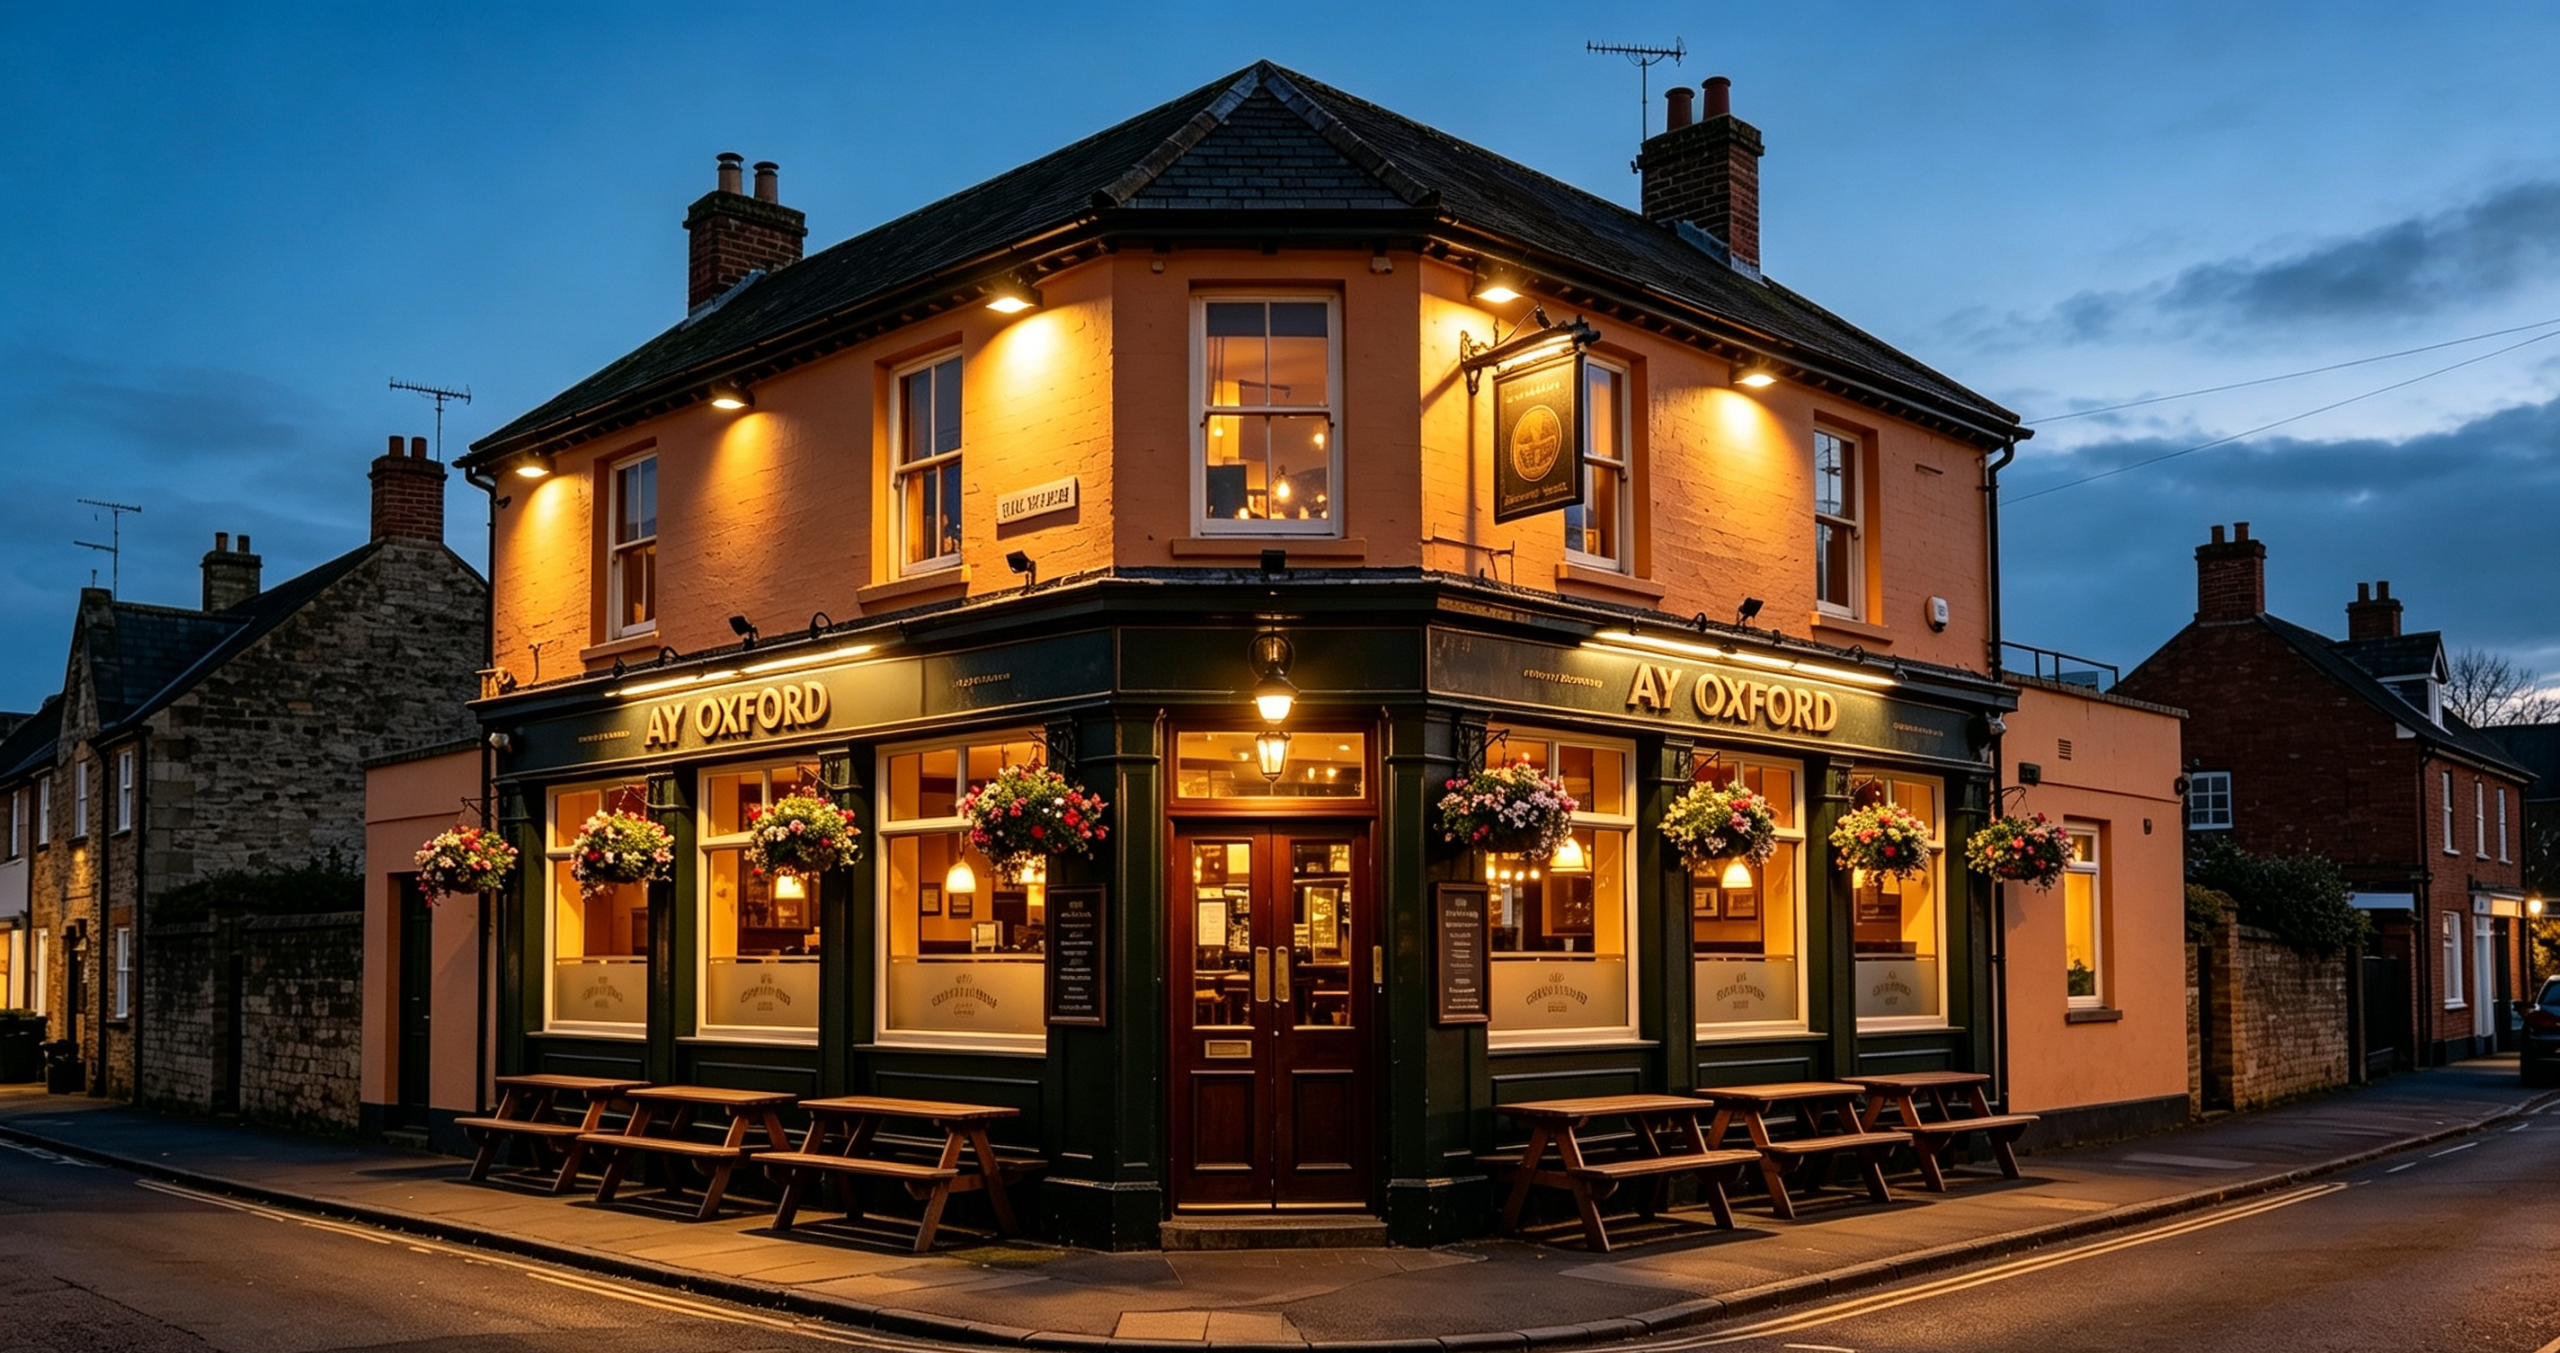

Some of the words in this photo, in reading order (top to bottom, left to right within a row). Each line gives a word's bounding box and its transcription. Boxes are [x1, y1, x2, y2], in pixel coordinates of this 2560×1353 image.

[644, 702, 686, 746] AY
[694, 681, 829, 738] OXFORD
[1627, 662, 1682, 709] AY
[1694, 673, 1838, 732] OXFORD
